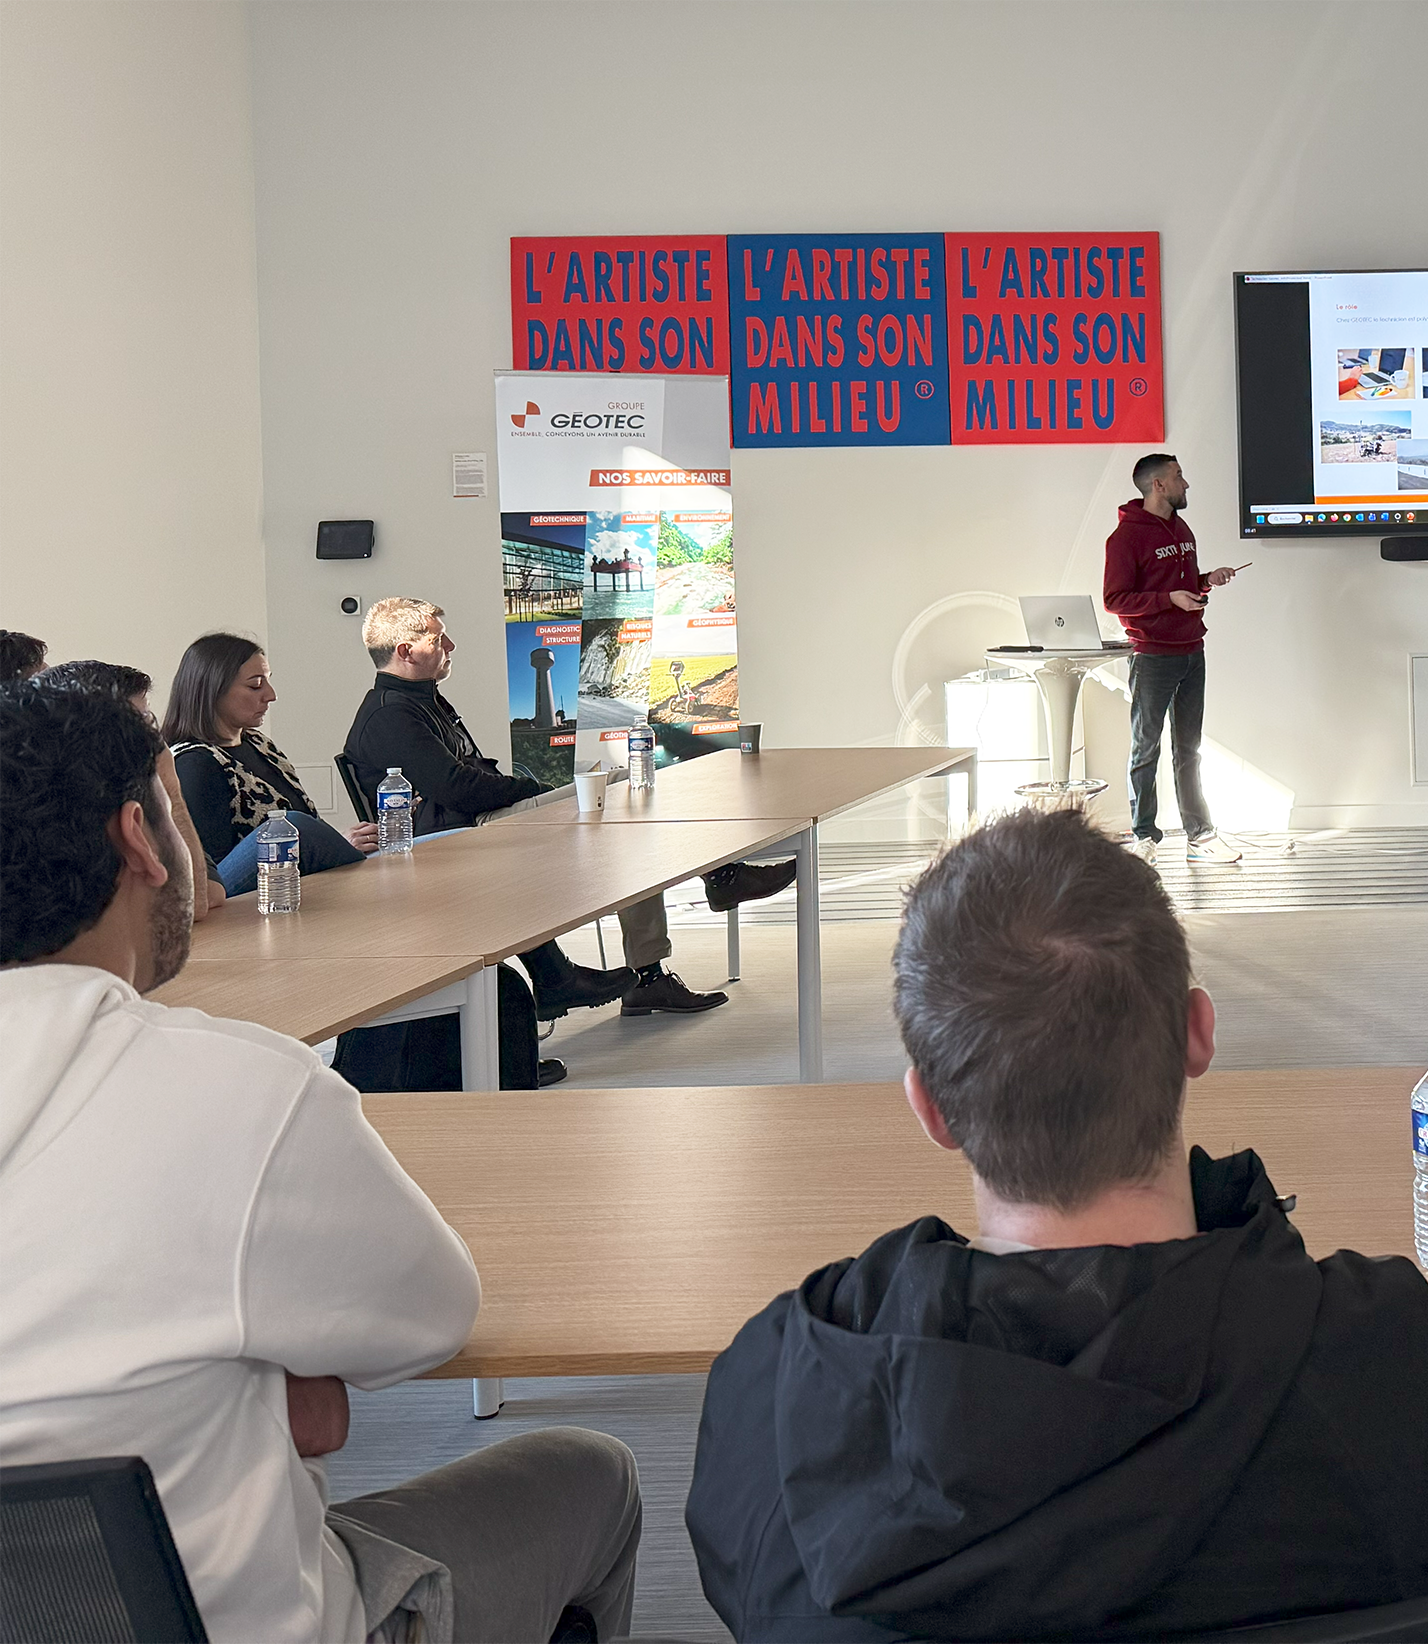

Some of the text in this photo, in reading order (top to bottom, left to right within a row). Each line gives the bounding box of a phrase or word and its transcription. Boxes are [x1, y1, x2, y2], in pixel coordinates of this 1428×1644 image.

[526, 250, 712, 303] L'ARTISTE
[744, 248, 930, 300] L'ARTISTE
[961, 246, 1146, 299] L'ARTISTE
[527, 316, 713, 370] DANS SON
[745, 314, 933, 367] DANS SON
[962, 312, 1146, 365] DANS SON
[608, 402, 645, 410] GROUPE
[748, 381, 900, 433] MILIEU
[965, 379, 1115, 430] MILIEU
[599, 472, 726, 484] NOS SAVOIR-FAIRE
[533, 515, 584, 524] GÉOTECHNIQUE
[539, 626, 580, 634] DIAGNOSTIC
[546, 636, 580, 644] STRUCTURE
[621, 632, 651, 640] NATURELS
[554, 736, 574, 744] ROUTE
[698, 723, 737, 732] EXPLORATION
